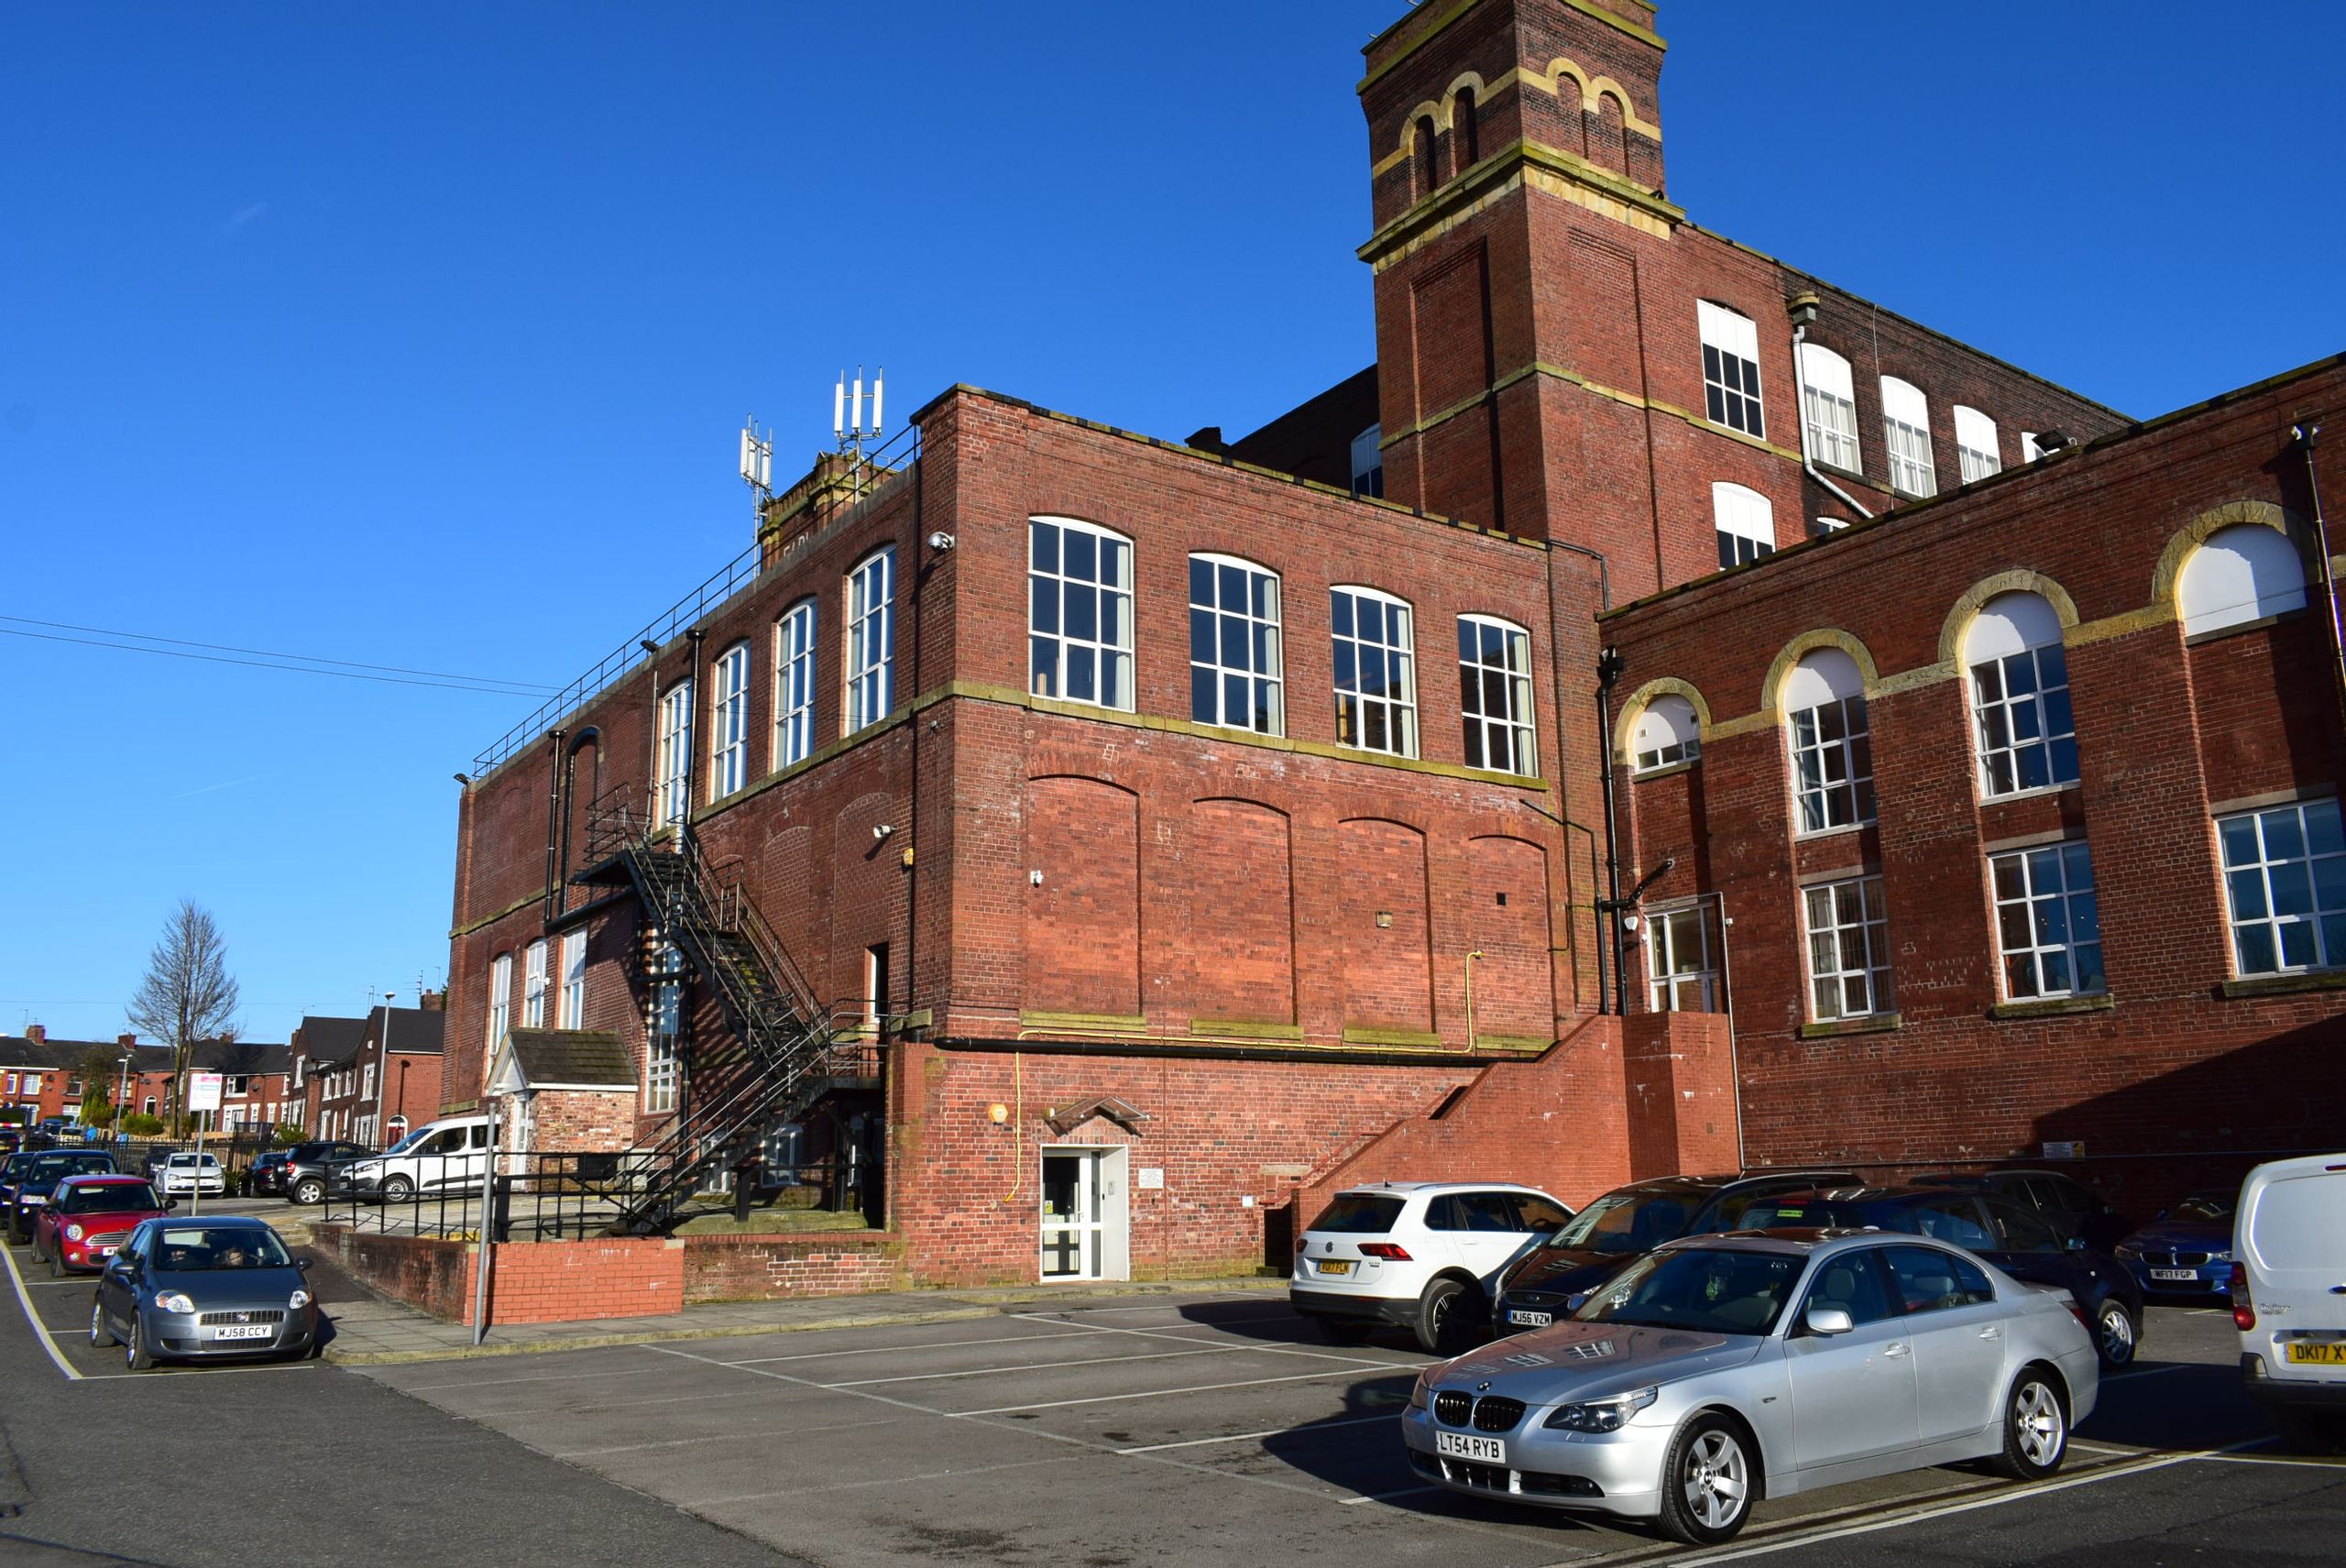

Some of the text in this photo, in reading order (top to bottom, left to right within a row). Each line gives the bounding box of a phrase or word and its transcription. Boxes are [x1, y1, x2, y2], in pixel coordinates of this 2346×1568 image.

[1512, 1312, 1550, 1325] MJ56 VZM
[218, 1326, 268, 1338] MJ58 CCY
[2296, 1344, 2328, 1360] DK17
[1440, 1433, 1499, 1458] LT54 RYB
